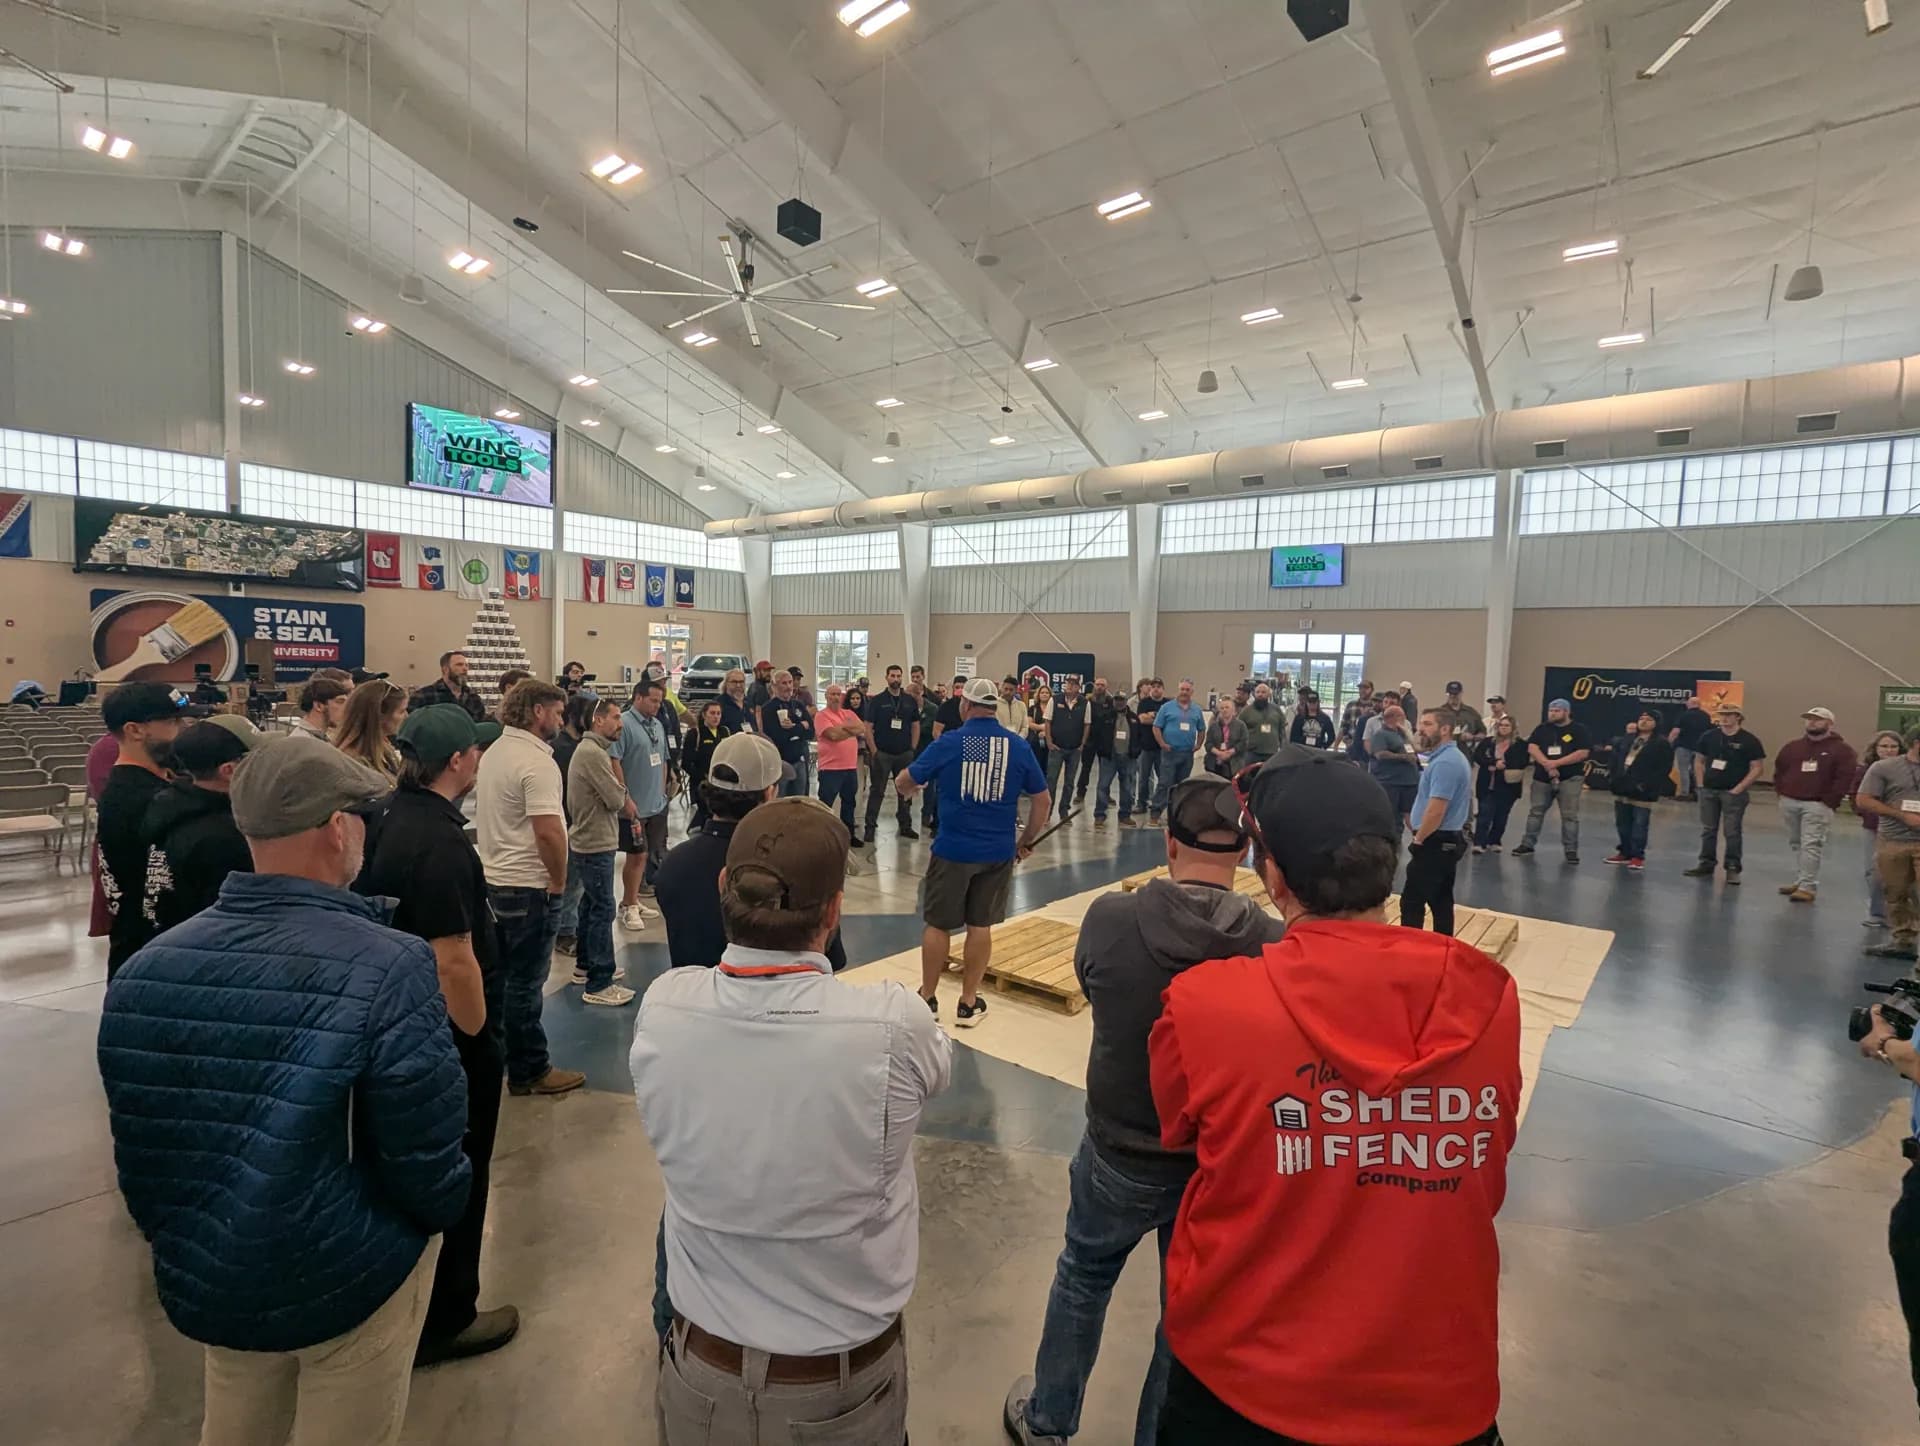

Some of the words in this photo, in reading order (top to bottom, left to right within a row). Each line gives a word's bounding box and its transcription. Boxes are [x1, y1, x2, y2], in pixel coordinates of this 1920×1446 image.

[446, 432, 522, 460] WING
[447, 448, 519, 471] TOOLS
[254, 607, 327, 626] STAIN
[254, 625, 273, 640] &
[276, 625, 340, 643] SEAL
[273, 647, 335, 657] NIVERSITY
[1595, 684, 1693, 699] mySalesman
[1296, 1059, 1342, 1090] The
[1321, 1130, 1493, 1170] FENCE
